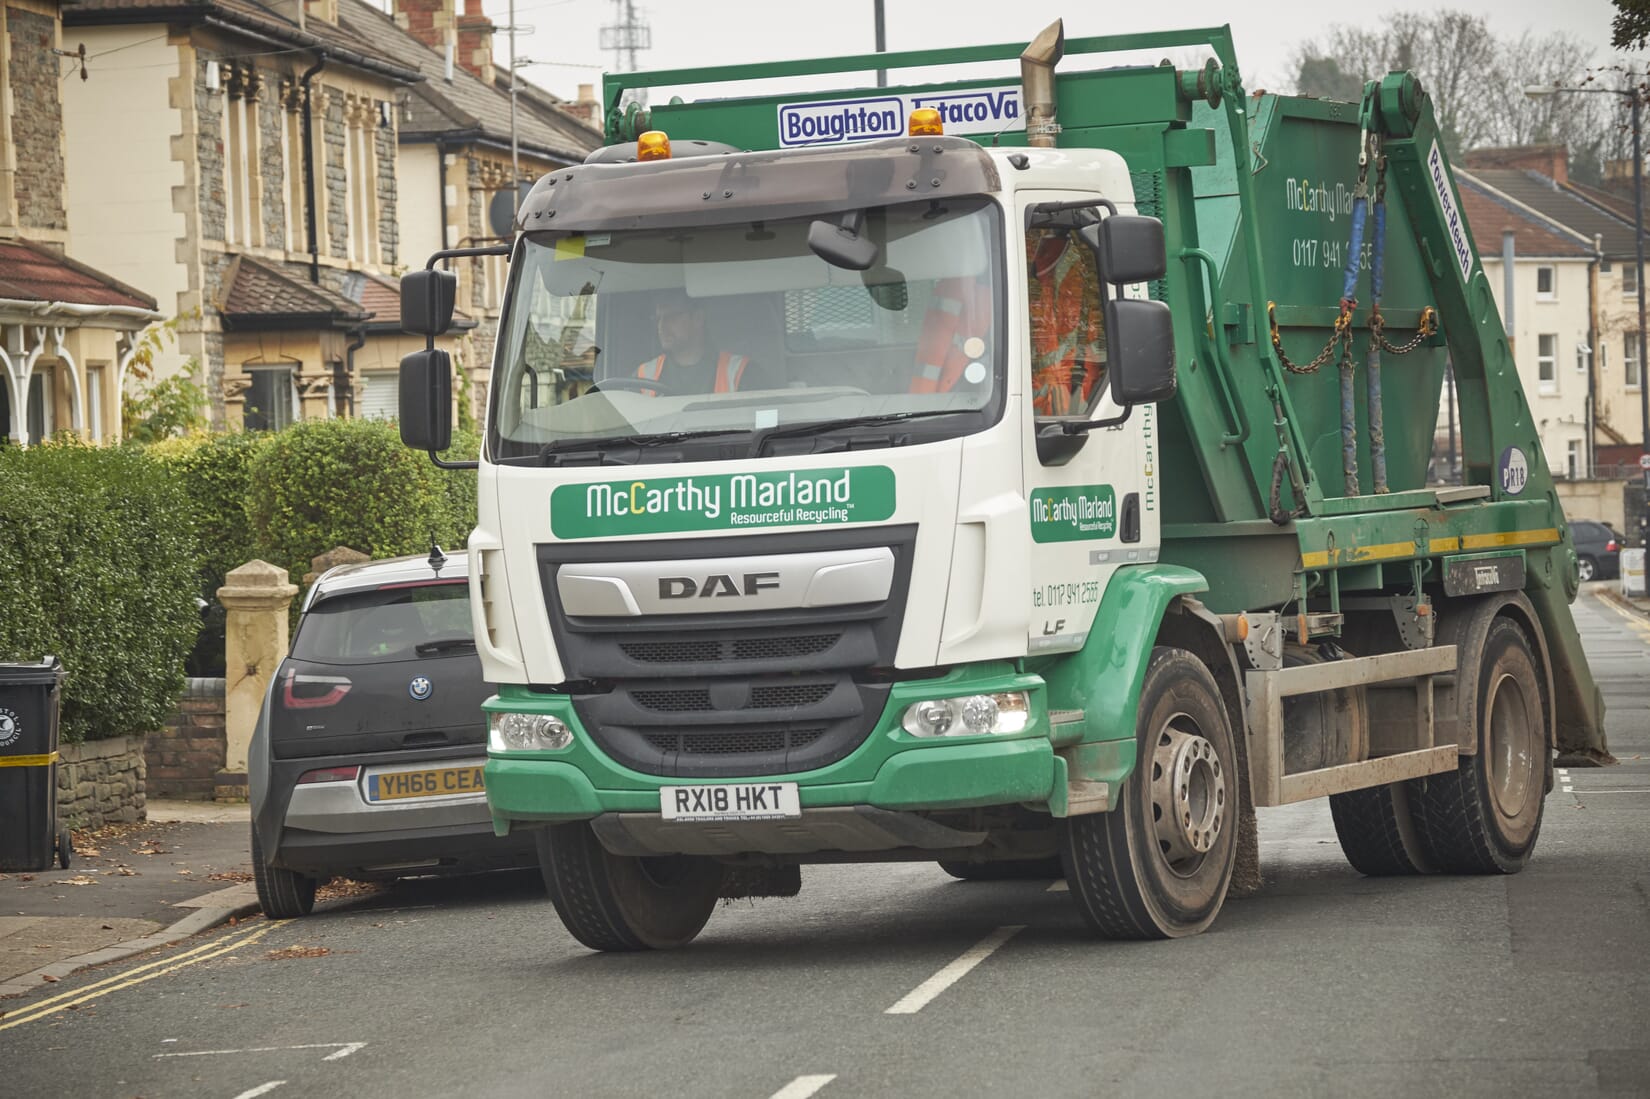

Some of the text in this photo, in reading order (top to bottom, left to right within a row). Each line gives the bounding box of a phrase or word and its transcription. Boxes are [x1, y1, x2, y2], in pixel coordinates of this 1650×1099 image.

[787, 106, 896, 140] Boughton
[1286, 177, 1335, 222] McCarthy
[1430, 148, 1470, 274] Power-Reach
[1293, 238, 1318, 267] 0117
[1322, 240, 1341, 268] 941
[1503, 466, 1525, 488] PR18
[585, 469, 851, 519] McCarthy Marland
[730, 508, 794, 525] Resourceful
[796, 506, 849, 523] Recycling
[1033, 496, 1078, 526] McCarthy
[1078, 494, 1113, 519] Marland
[658, 572, 781, 600] DAF
[1047, 583, 1065, 607] 0117
[1067, 583, 1080, 605] 941
[1081, 581, 1099, 604] 2555
[1043, 619, 1066, 636] LF
[383, 769, 484, 795] YH66 CEA
[675, 786, 783, 813] RX18 HKT
